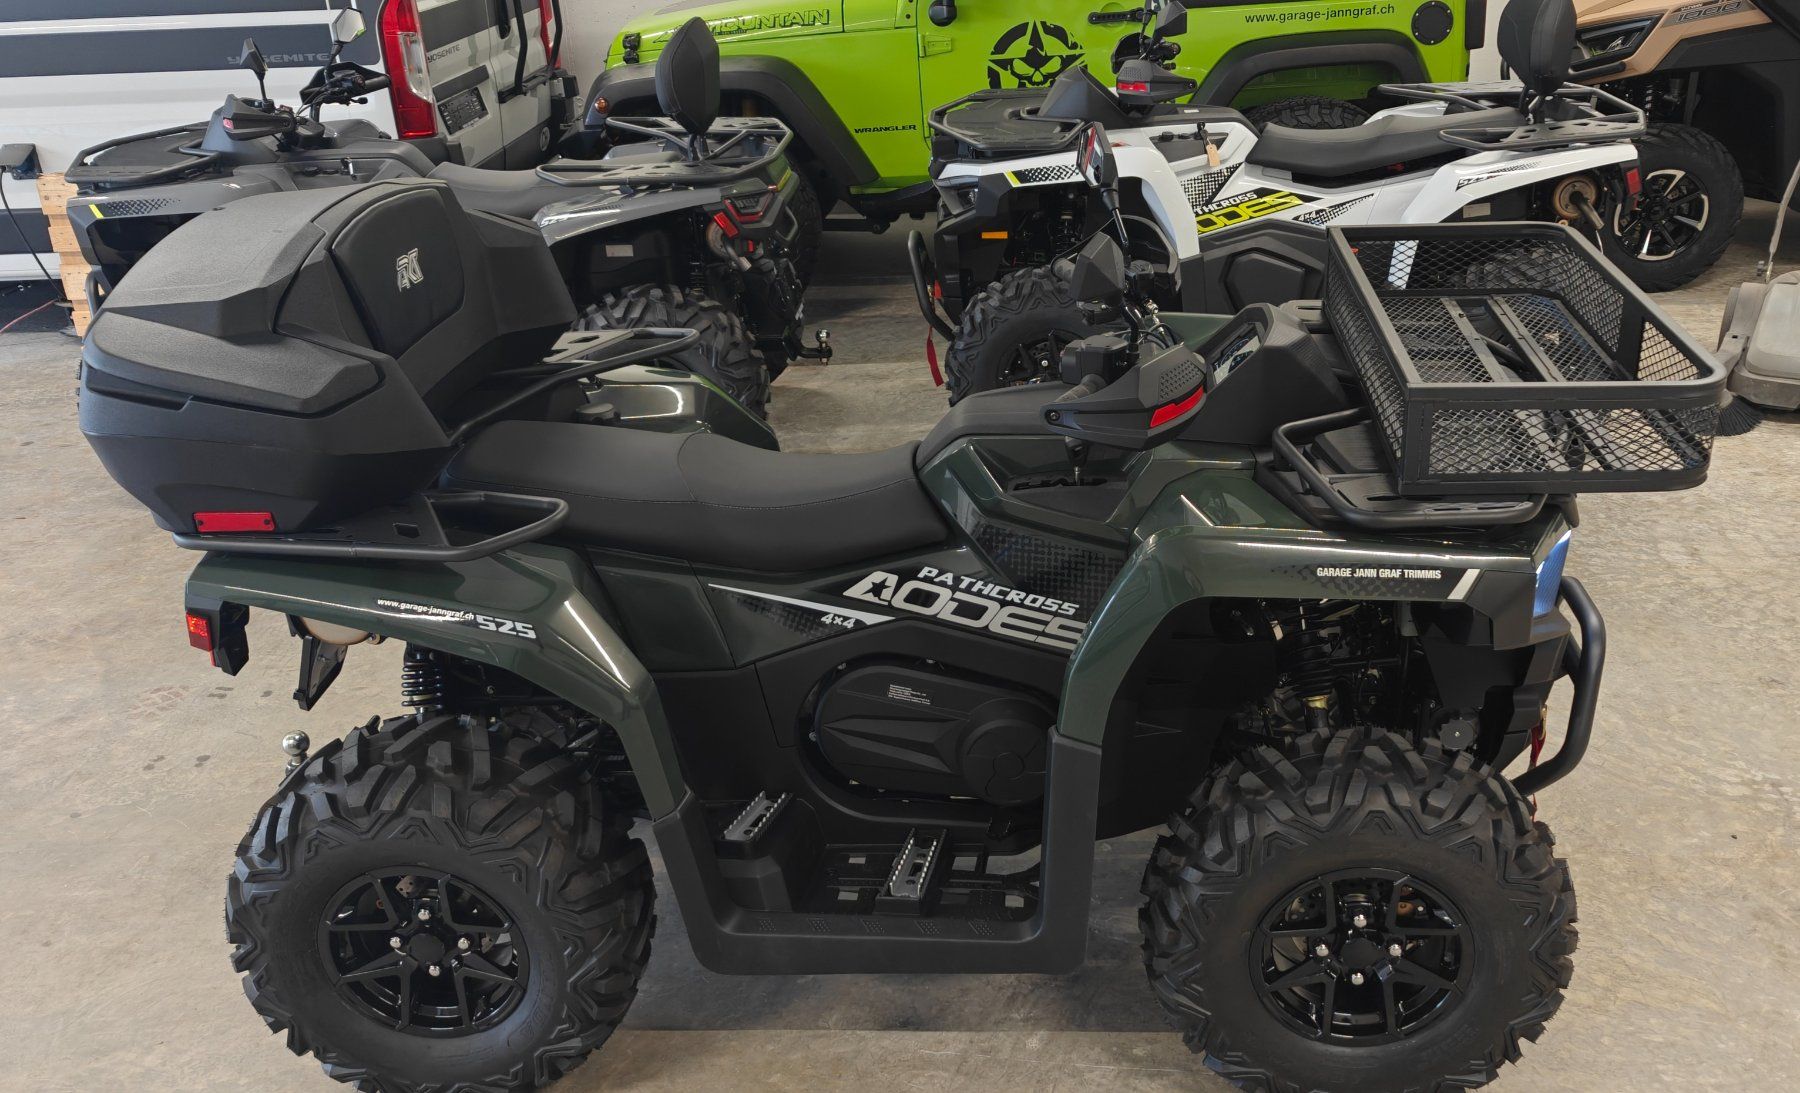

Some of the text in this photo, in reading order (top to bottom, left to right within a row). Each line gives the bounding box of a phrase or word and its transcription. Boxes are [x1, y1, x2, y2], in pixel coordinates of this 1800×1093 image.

[1244, 4, 1395, 23] www.garage-janngraf.ch
[226, 53, 329, 65] YSEMITE
[854, 124, 917, 133] WRANGLER
[1196, 191, 1303, 233] ODES
[1316, 567, 1442, 579] GARAGE JANN GRAF TRIMMIS
[917, 566, 1080, 616] PATHCROSS
[377, 598, 475, 621] www.garage-janngraf.ch
[842, 570, 1089, 650] AODES
[476, 614, 537, 640] 525
